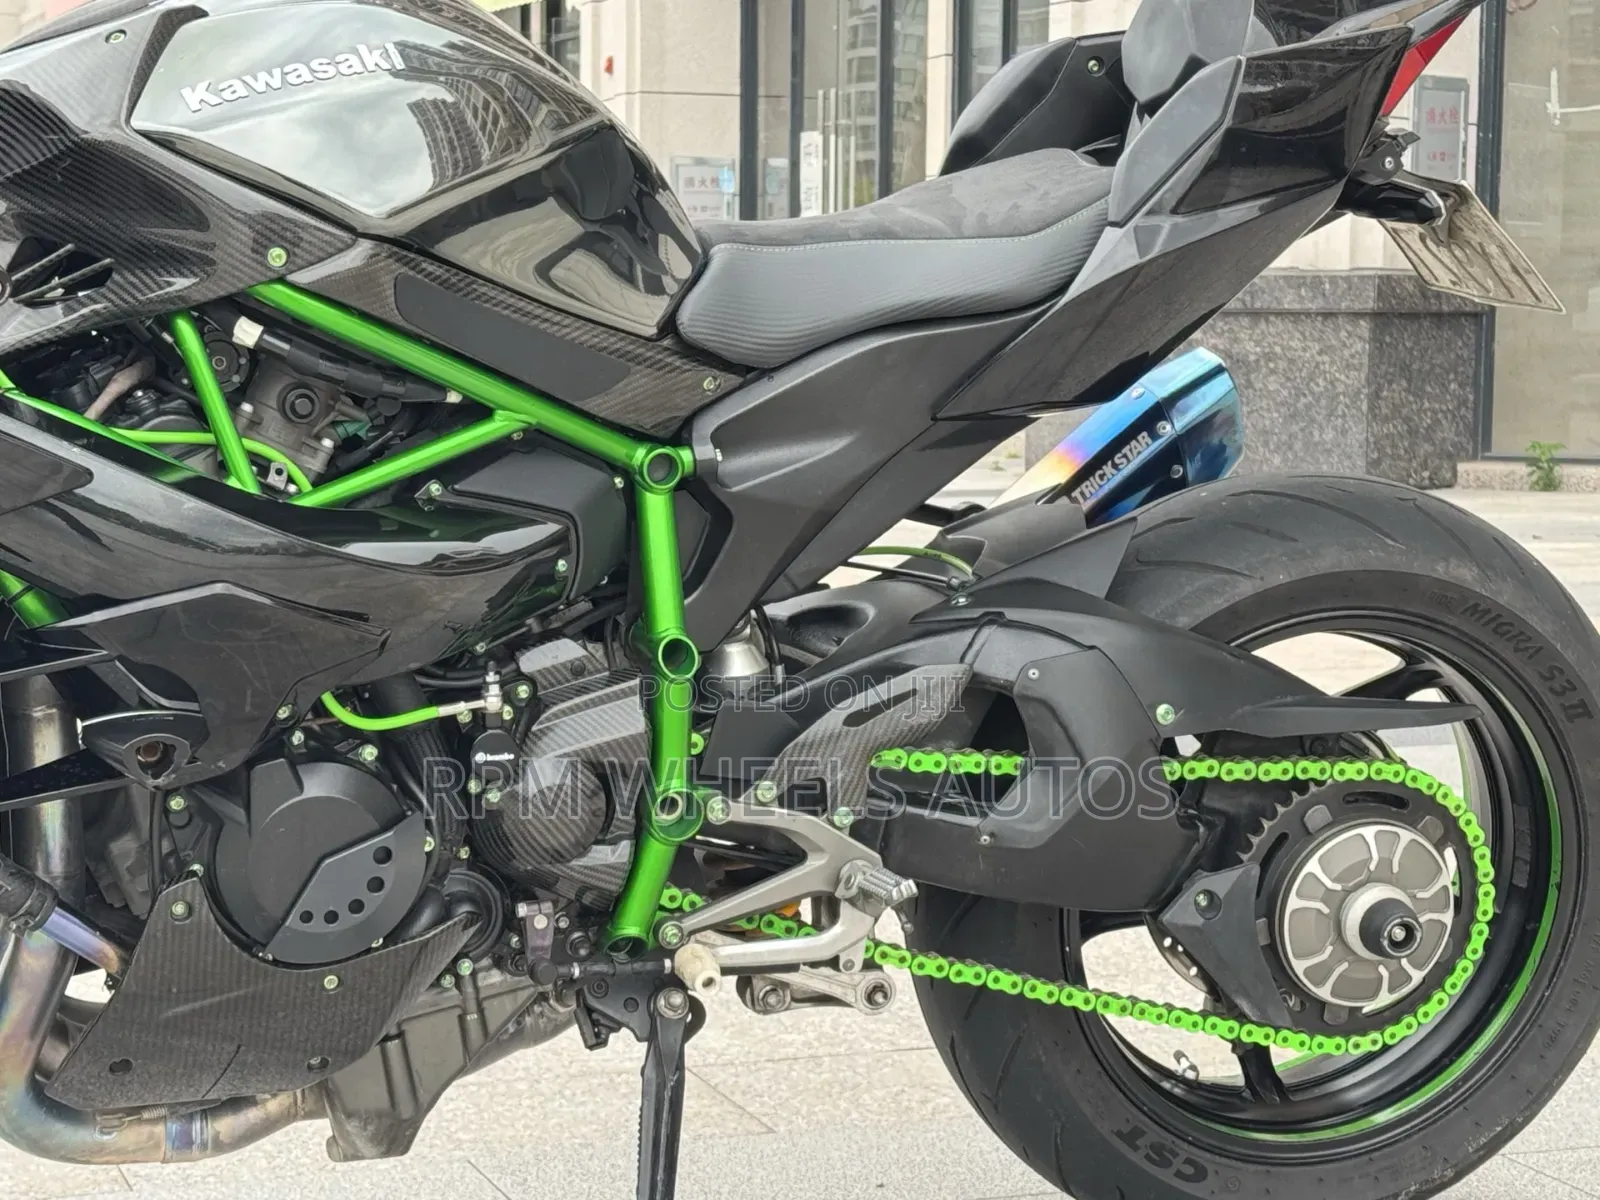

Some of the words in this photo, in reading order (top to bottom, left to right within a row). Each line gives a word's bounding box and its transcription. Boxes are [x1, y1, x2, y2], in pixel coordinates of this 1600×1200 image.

[180, 42, 406, 113] Kawasaki
[1071, 460, 1118, 504] TRICK
[1113, 431, 1153, 469] STAR
[1459, 602, 1544, 660] MIGRA
[1111, 1124, 1209, 1183] CST
